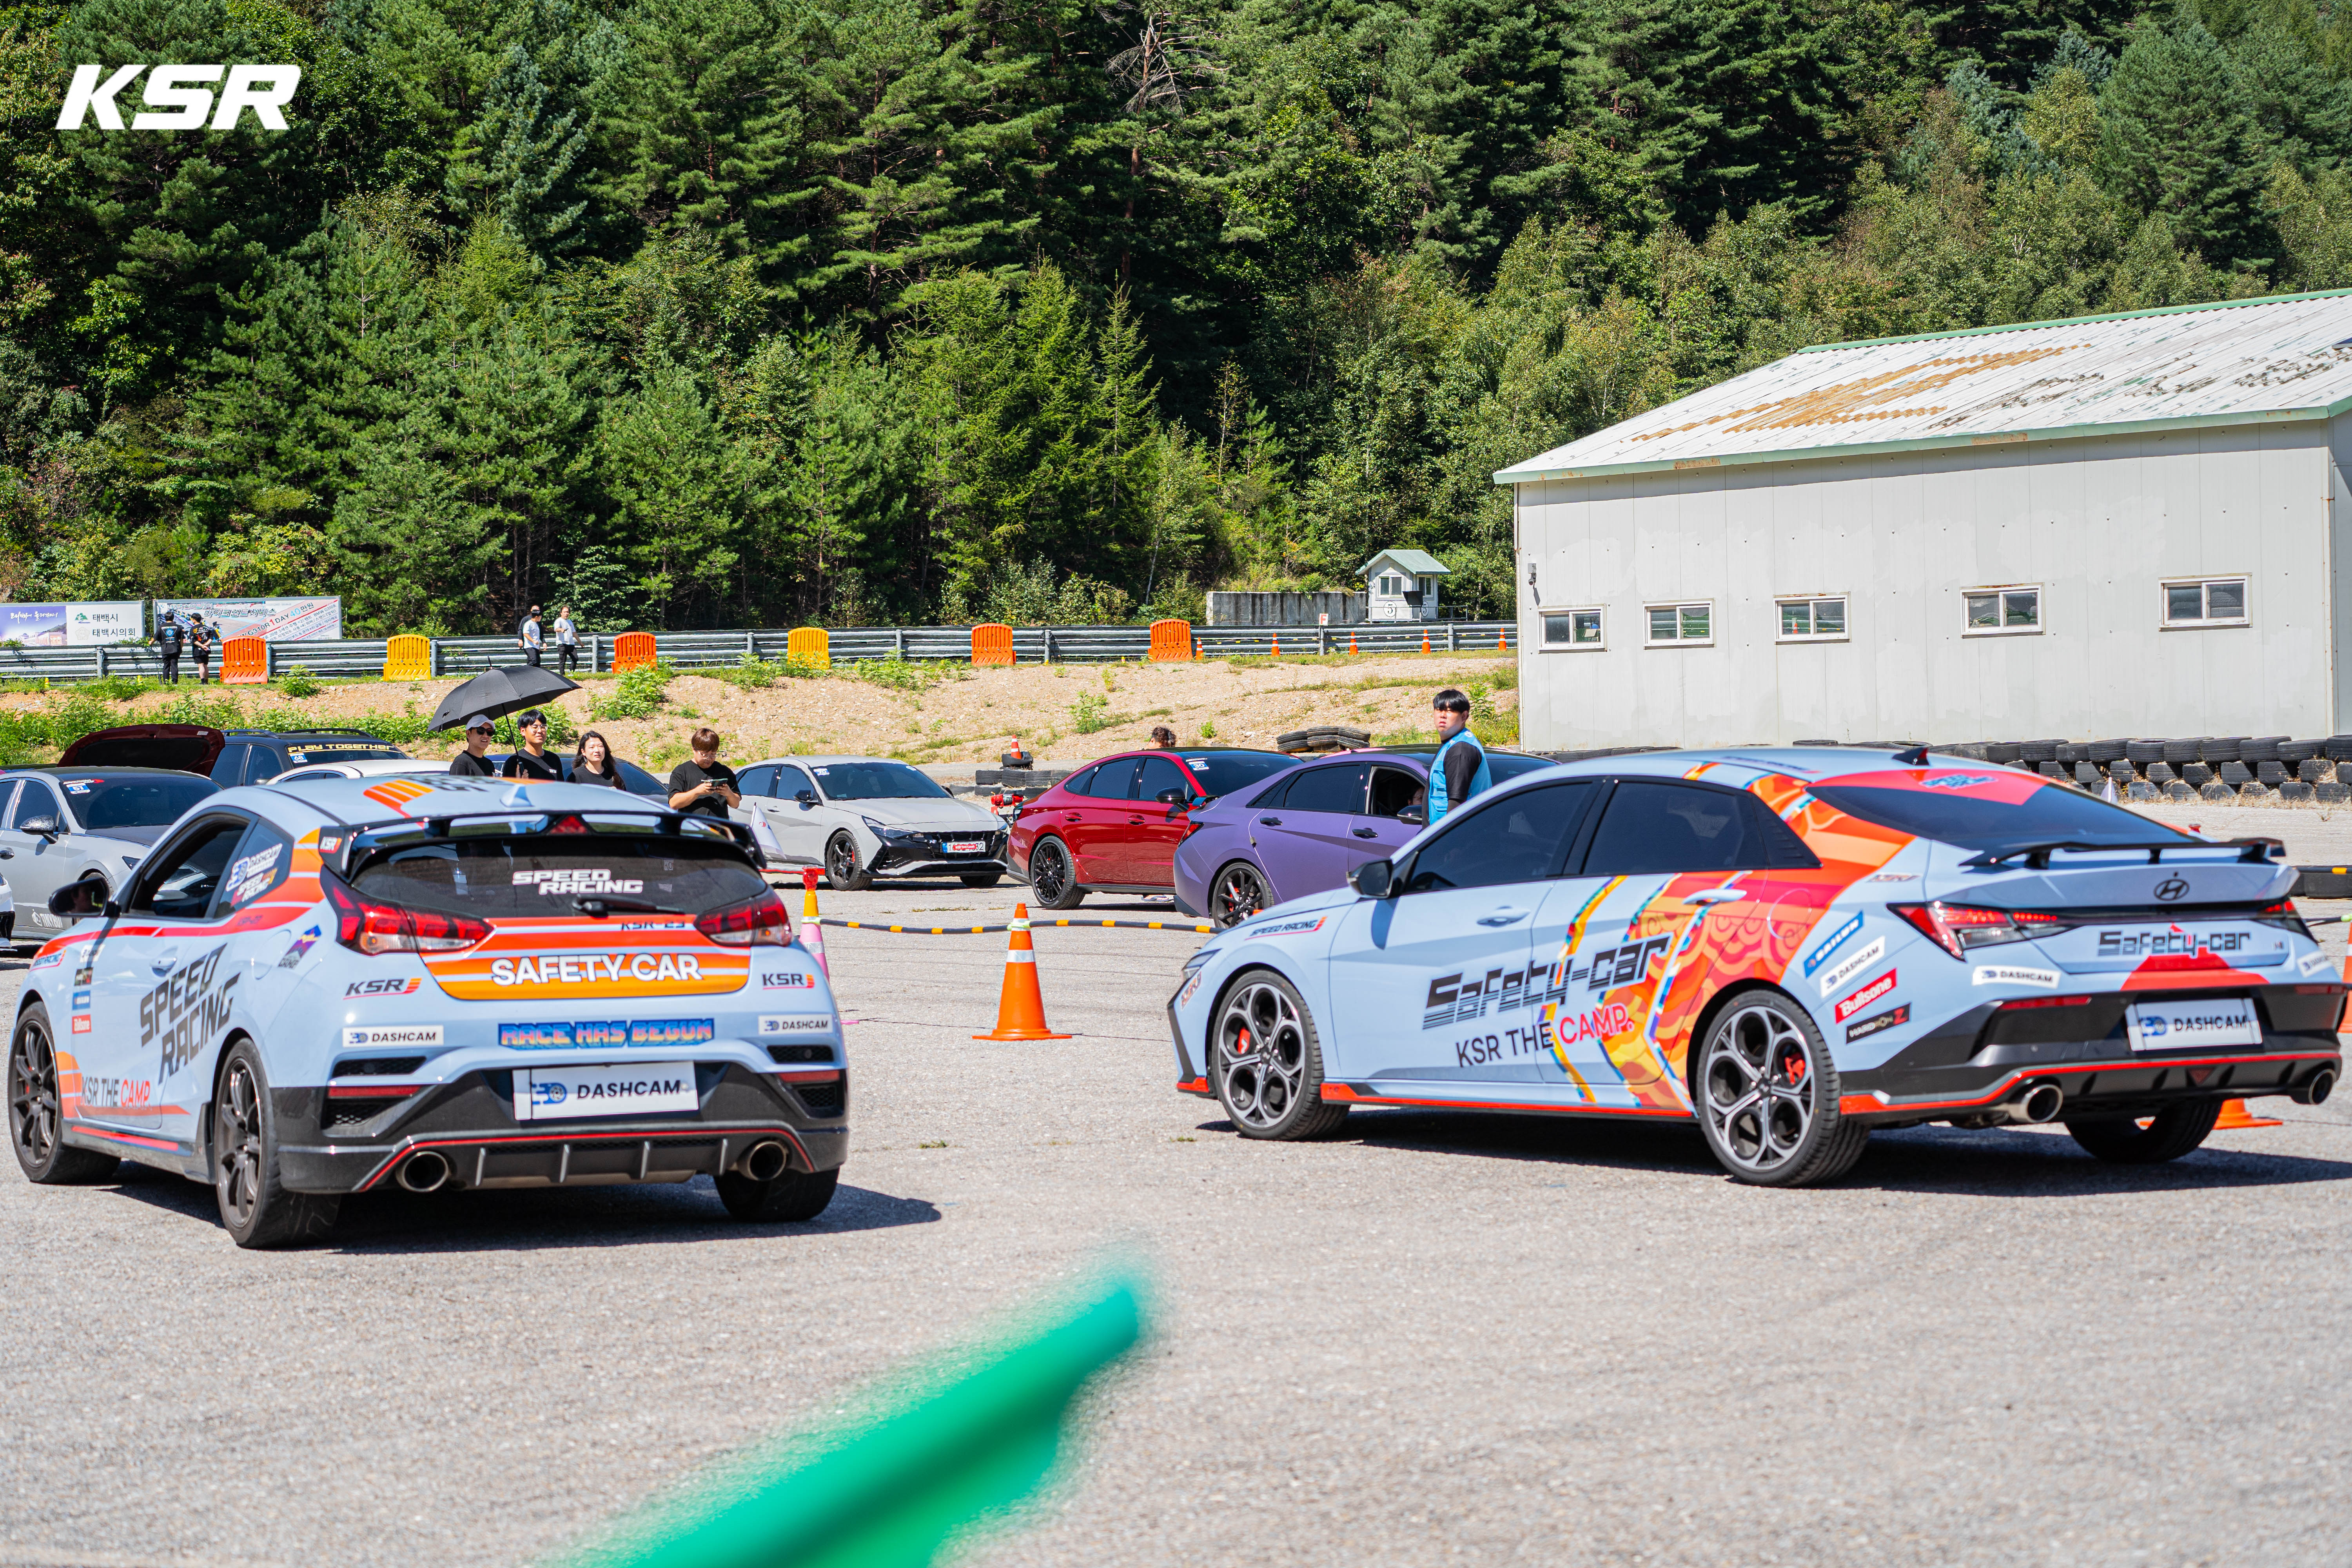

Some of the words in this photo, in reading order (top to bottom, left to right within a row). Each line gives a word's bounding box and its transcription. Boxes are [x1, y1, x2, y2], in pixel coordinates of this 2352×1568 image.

[249, 608, 277, 617] 서비스
[1388, 604, 1393, 614] 5
[93, 613, 118, 623] 태백시
[248, 623, 270, 635] G310R
[275, 613, 290, 623] DAY
[1320, 615, 1327, 624] F
[93, 628, 135, 637] 태백시의회
[320, 837, 336, 851] KSR
[513, 869, 611, 885] SPEED
[539, 880, 643, 895] RACING
[1250, 925, 1282, 936] SPEED
[1282, 920, 1318, 931] RACING
[2098, 931, 2250, 956] Safety-car
[491, 954, 627, 986] SAFETY
[630, 953, 703, 982] CAR
[1838, 946, 1879, 978] DASHCAM
[762, 973, 805, 987] KSR
[1422, 936, 1671, 1030] Safety-car
[2000, 971, 2053, 982] DASHCAM
[141, 943, 227, 1047] SPEED
[345, 978, 405, 997] KSR
[1839, 978, 1892, 1017] Bullsone
[158, 972, 241, 1084] RACING
[781, 1020, 829, 1031] DASHCAM
[2174, 1015, 2248, 1031] DASHCAM
[372, 1031, 437, 1042] DASHCAM
[501, 1024, 570, 1046] RACE
[575, 1023, 626, 1046] HAS
[630, 1021, 713, 1045] BEGUN
[1456, 1034, 1502, 1068] KSR
[1506, 1022, 1554, 1056] THE
[81, 1076, 98, 1104] KSR
[102, 1078, 119, 1106] THE
[577, 1079, 681, 1100] DASHCAM
